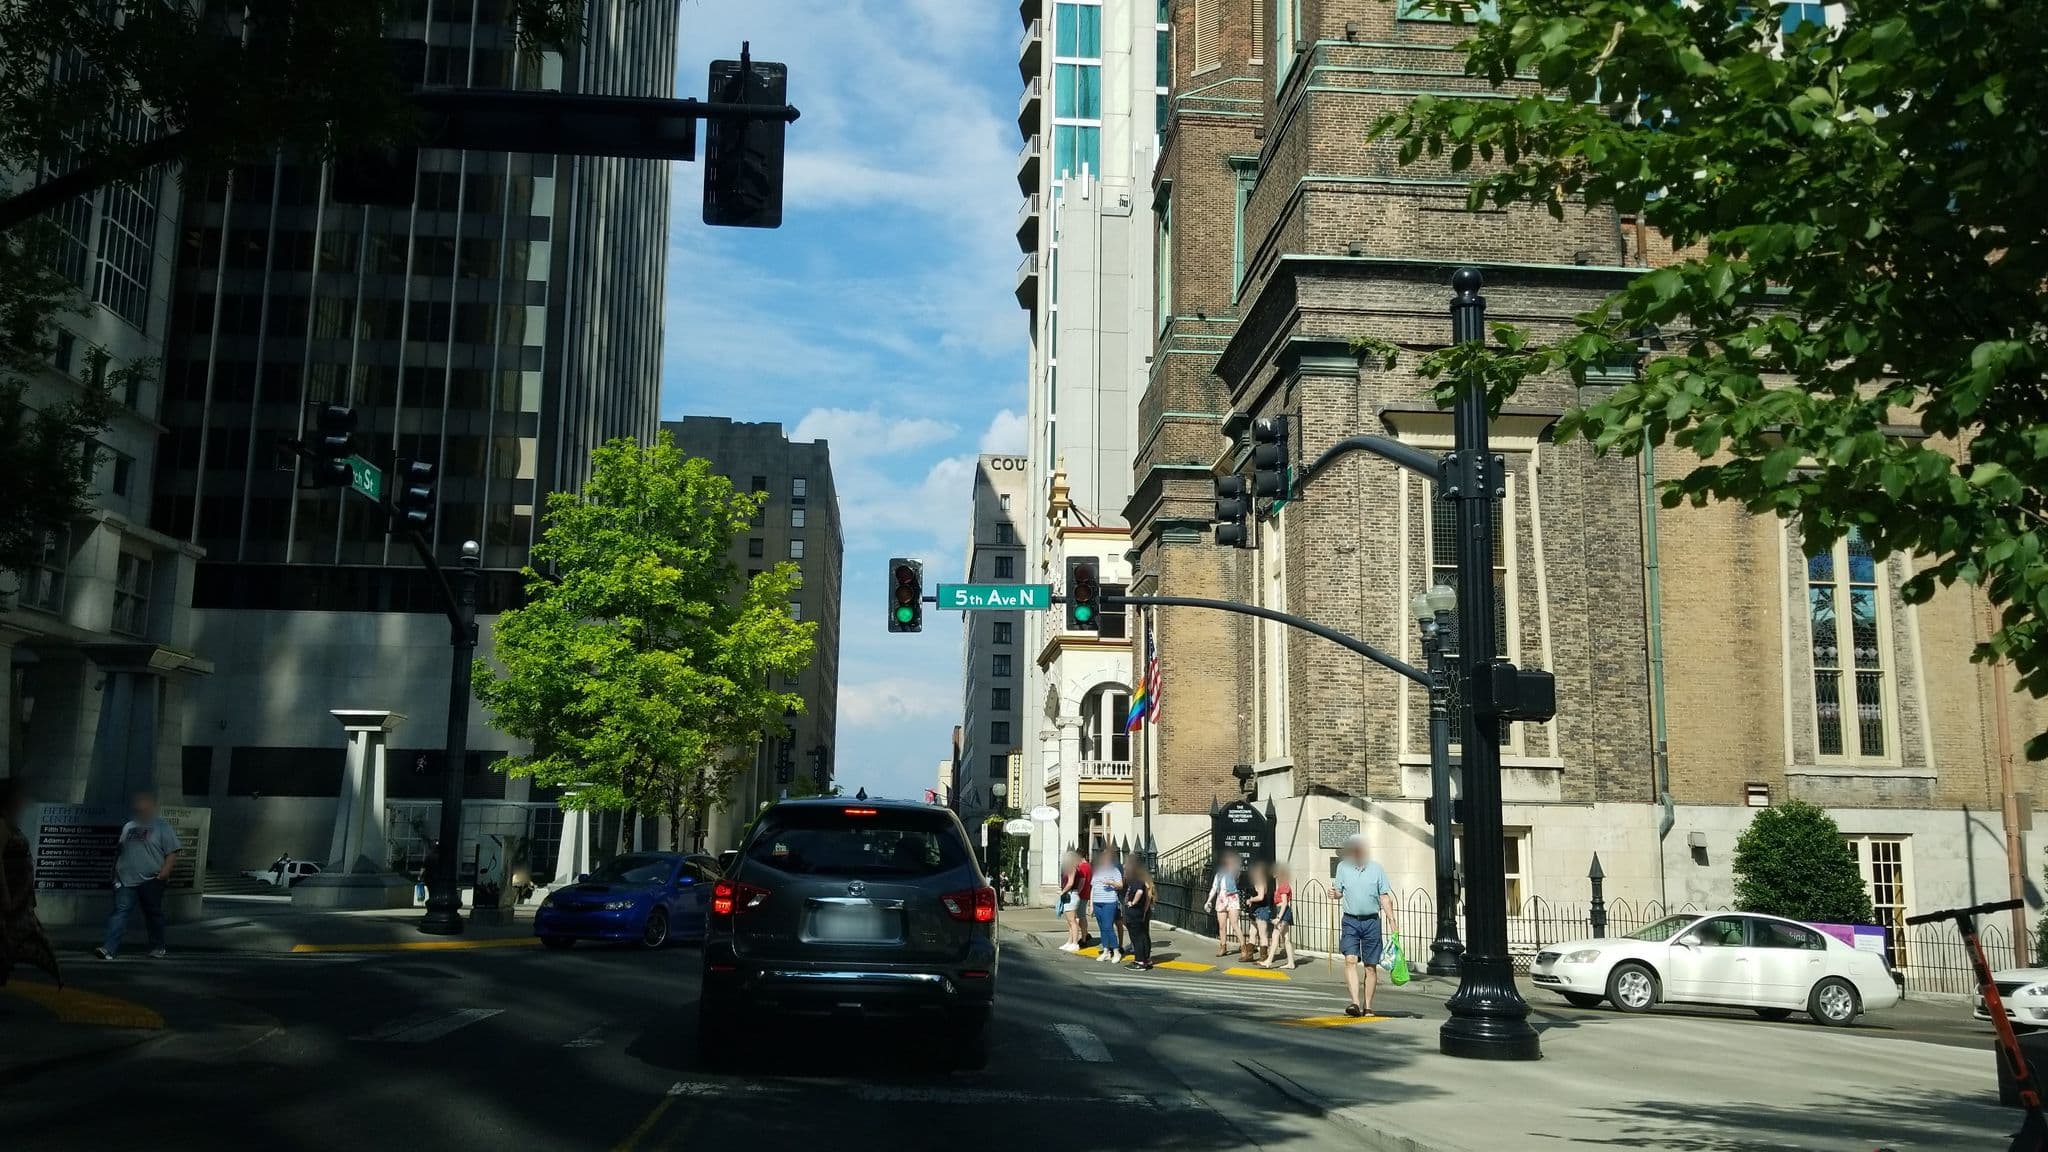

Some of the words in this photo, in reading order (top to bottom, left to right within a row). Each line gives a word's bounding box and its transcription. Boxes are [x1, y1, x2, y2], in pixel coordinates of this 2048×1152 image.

[363, 469, 374, 492] St
[955, 589, 983, 606] 5th
[987, 589, 1017, 606] Ave
[1020, 589, 1034, 606] N
